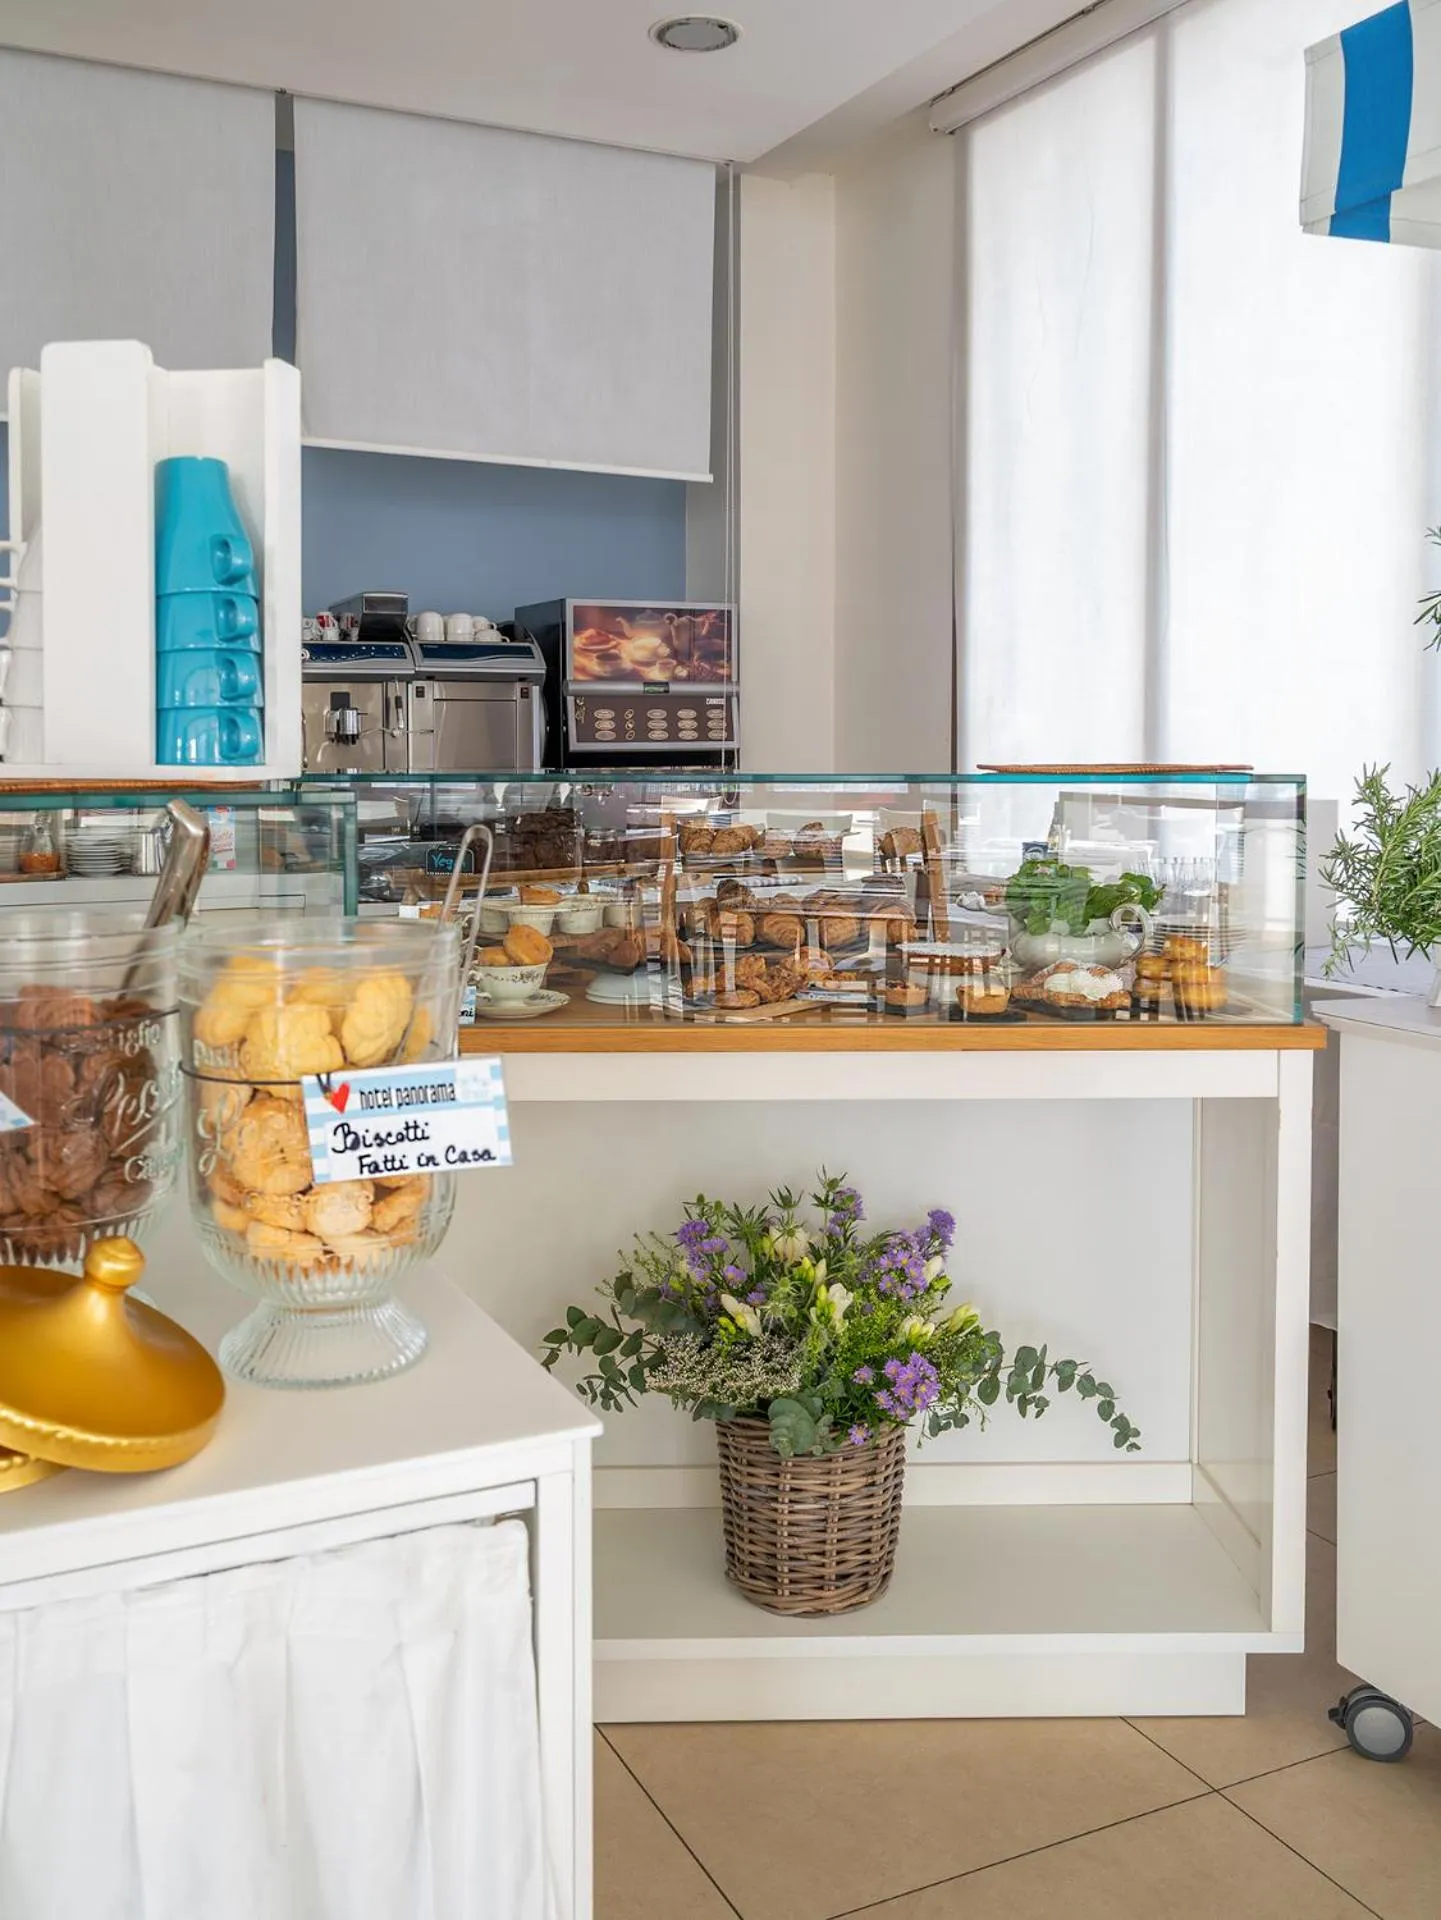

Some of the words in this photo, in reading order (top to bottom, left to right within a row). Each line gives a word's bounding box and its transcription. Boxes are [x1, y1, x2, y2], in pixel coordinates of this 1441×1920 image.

[359, 1085, 393, 1110] hotel
[396, 1081, 456, 1110] panorama
[331, 1120, 430, 1154] Biscotti
[358, 1154, 409, 1175] Fatti
[417, 1153, 440, 1168] in
[445, 1145, 497, 1165] Casa
